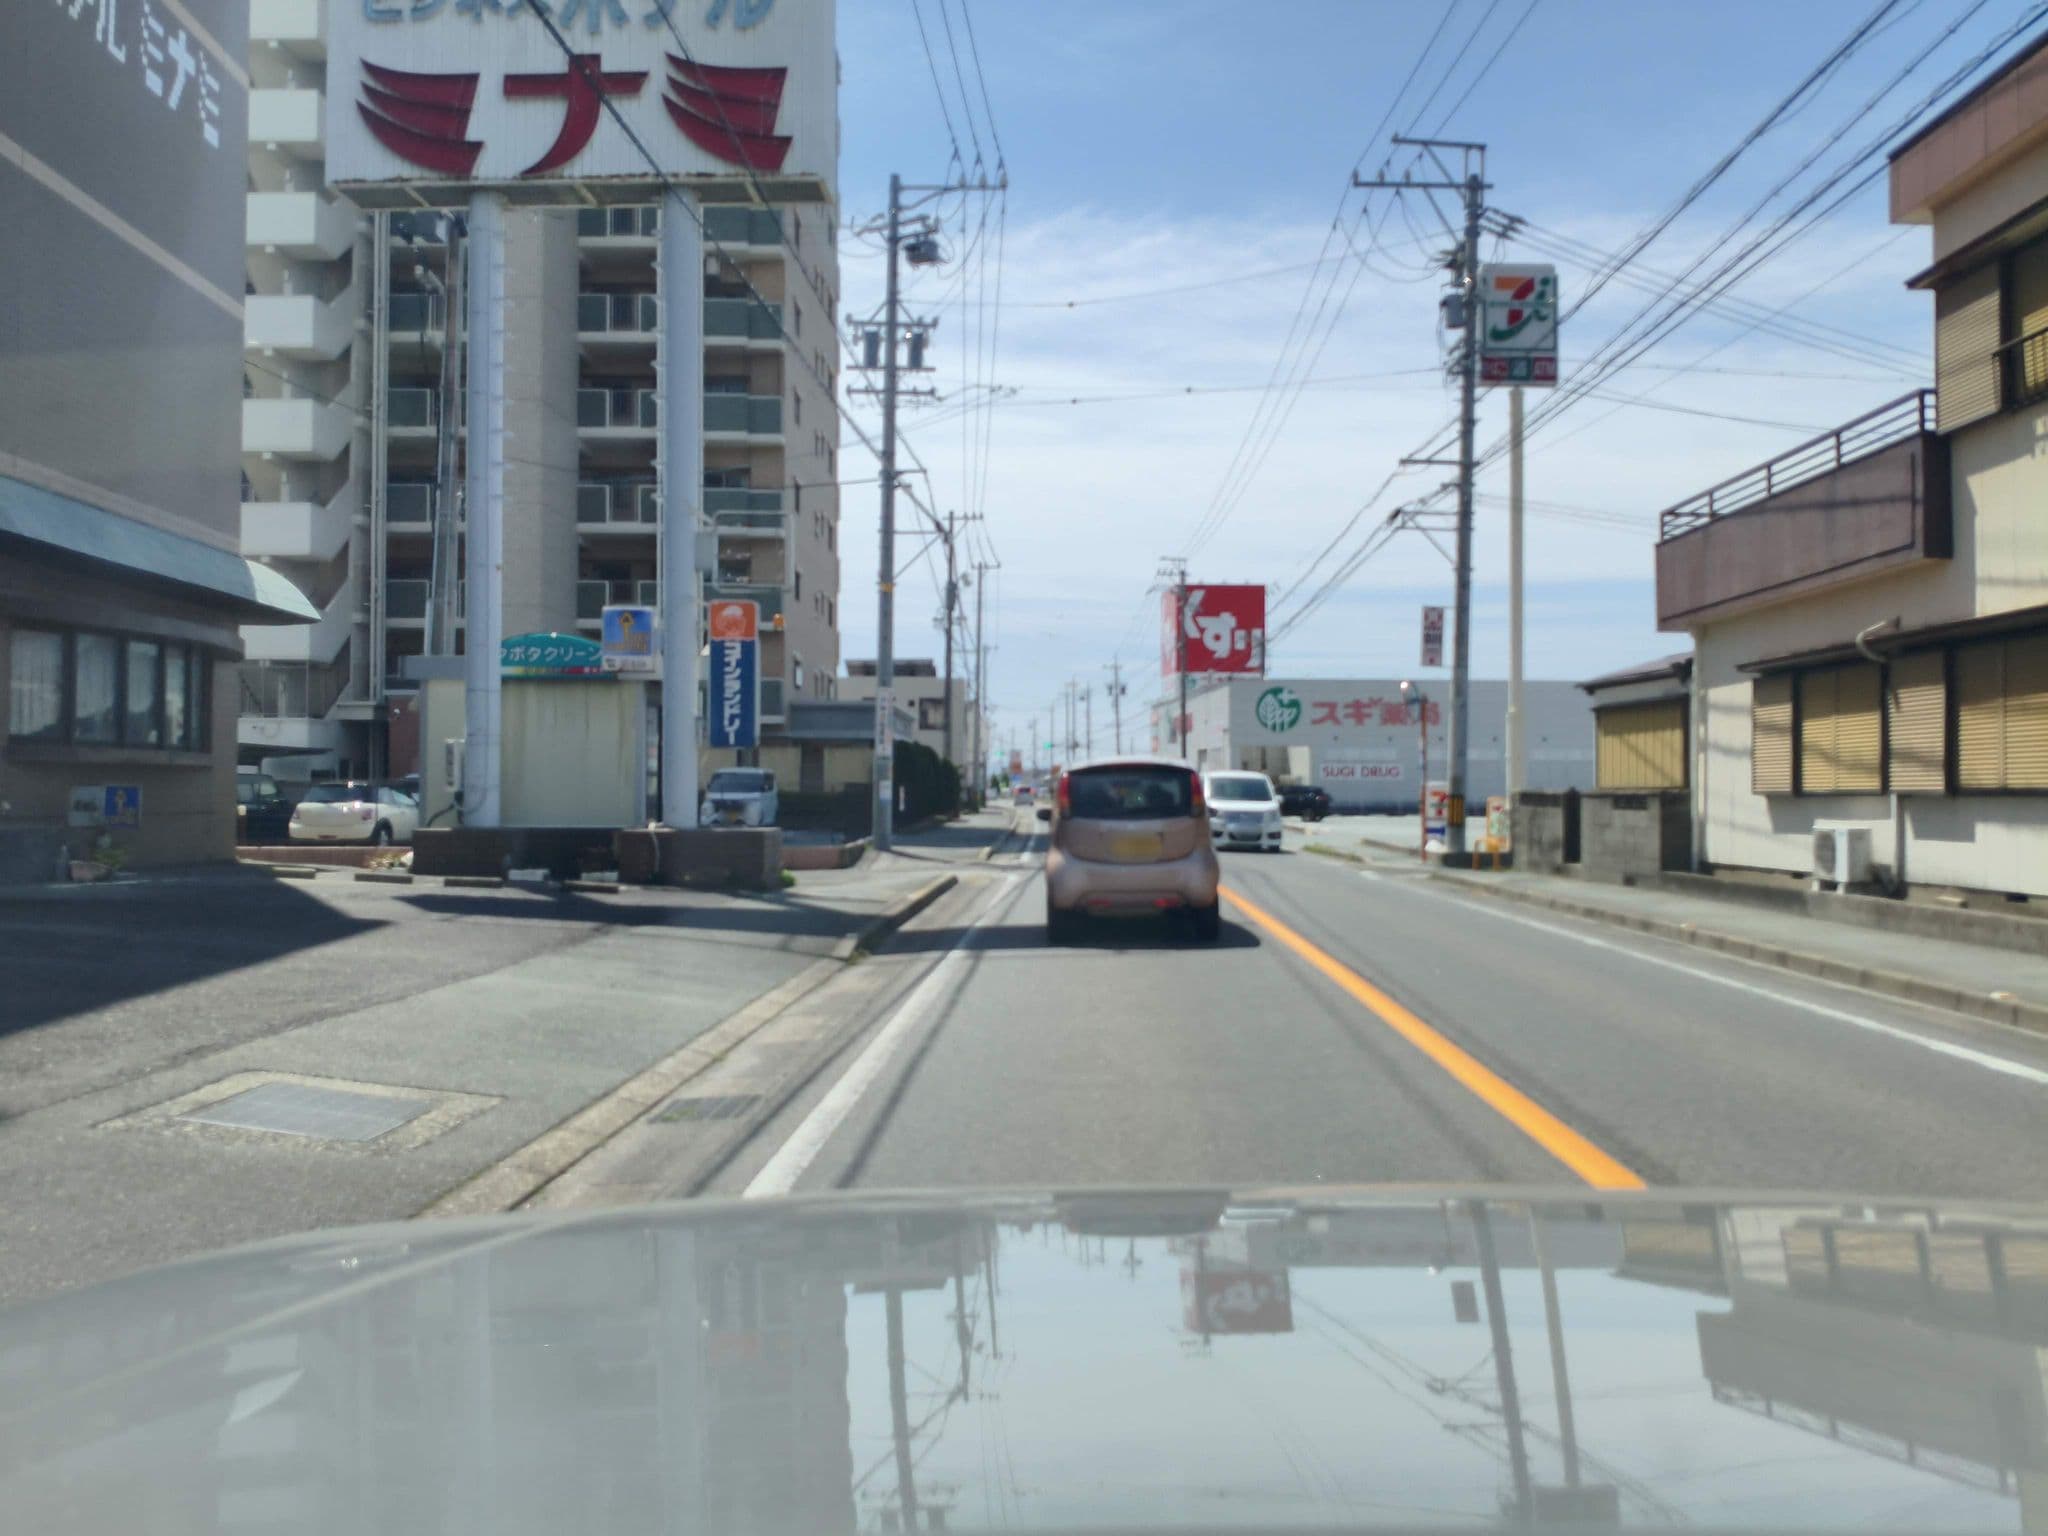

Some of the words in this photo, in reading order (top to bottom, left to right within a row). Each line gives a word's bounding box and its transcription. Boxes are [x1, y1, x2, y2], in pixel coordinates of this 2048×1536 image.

[355, 52, 793, 177] ミナミ
[1184, 589, 1263, 668] くすり
[723, 640, 742, 745] コインランドリー
[1322, 766, 1355, 778] SUGI
[1360, 766, 1400, 778] DRUG
